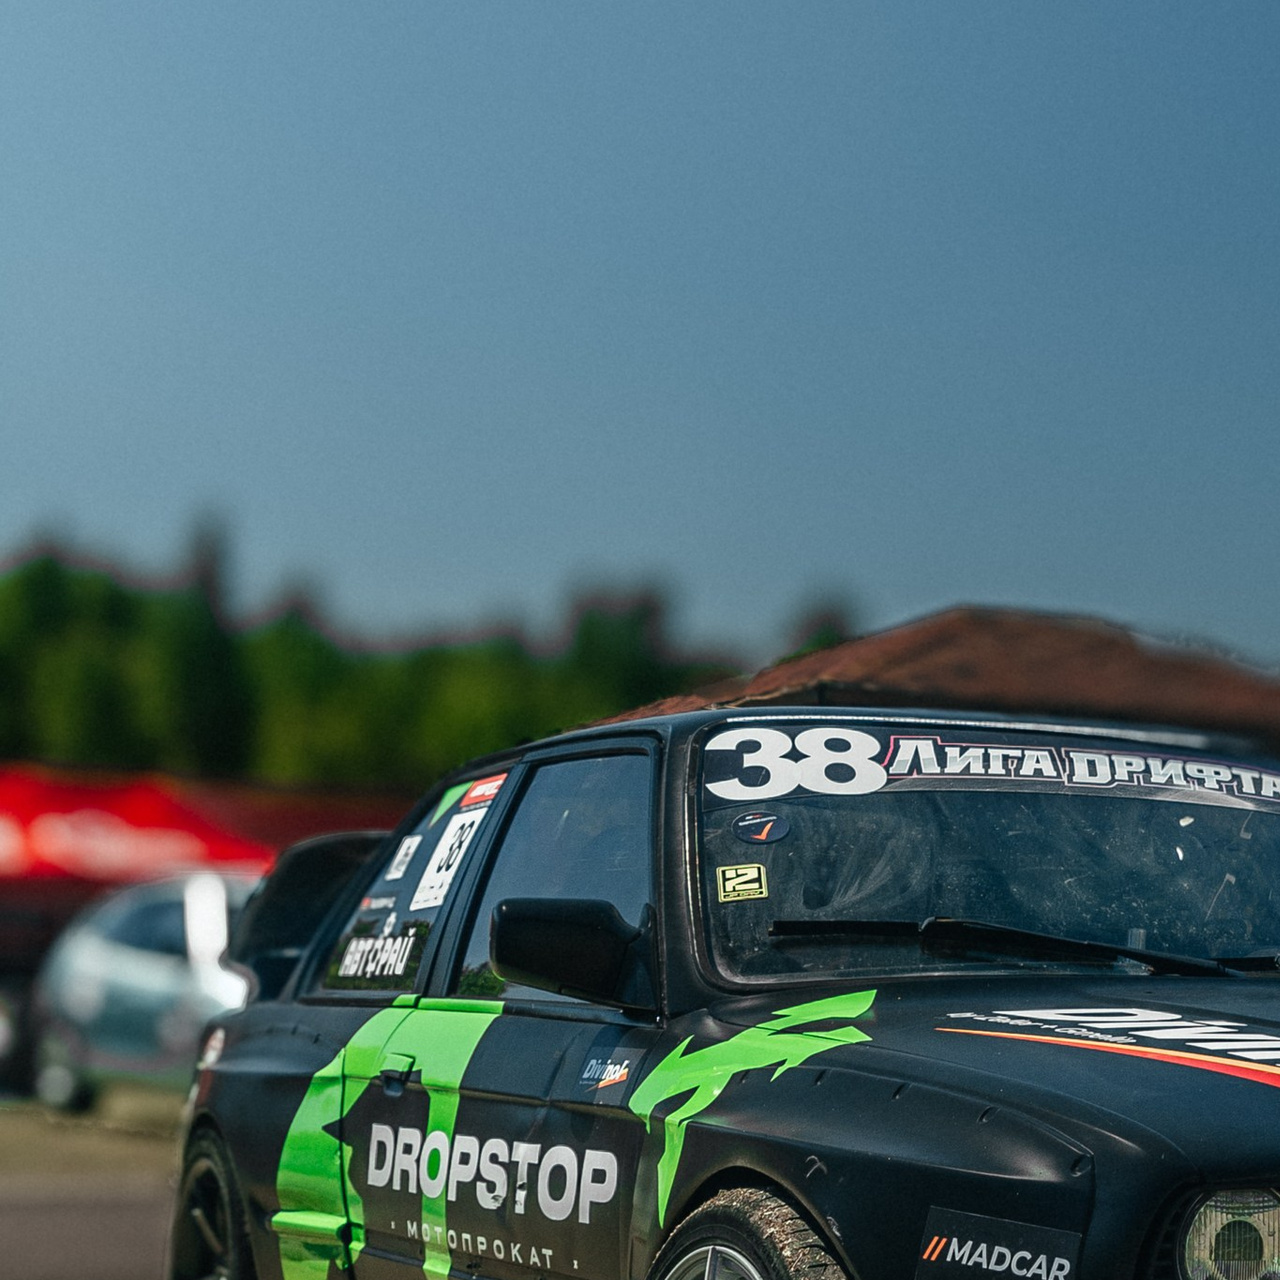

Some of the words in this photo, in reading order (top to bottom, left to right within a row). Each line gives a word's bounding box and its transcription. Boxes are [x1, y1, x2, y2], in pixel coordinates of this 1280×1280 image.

[705, 728, 888, 801] 38
[436, 820, 476, 874] 38
[582, 1059, 630, 1080] Divinol
[367, 1123, 618, 1224] DROPSTOP
[406, 1220, 554, 1269] МОТОПРОКАТ
